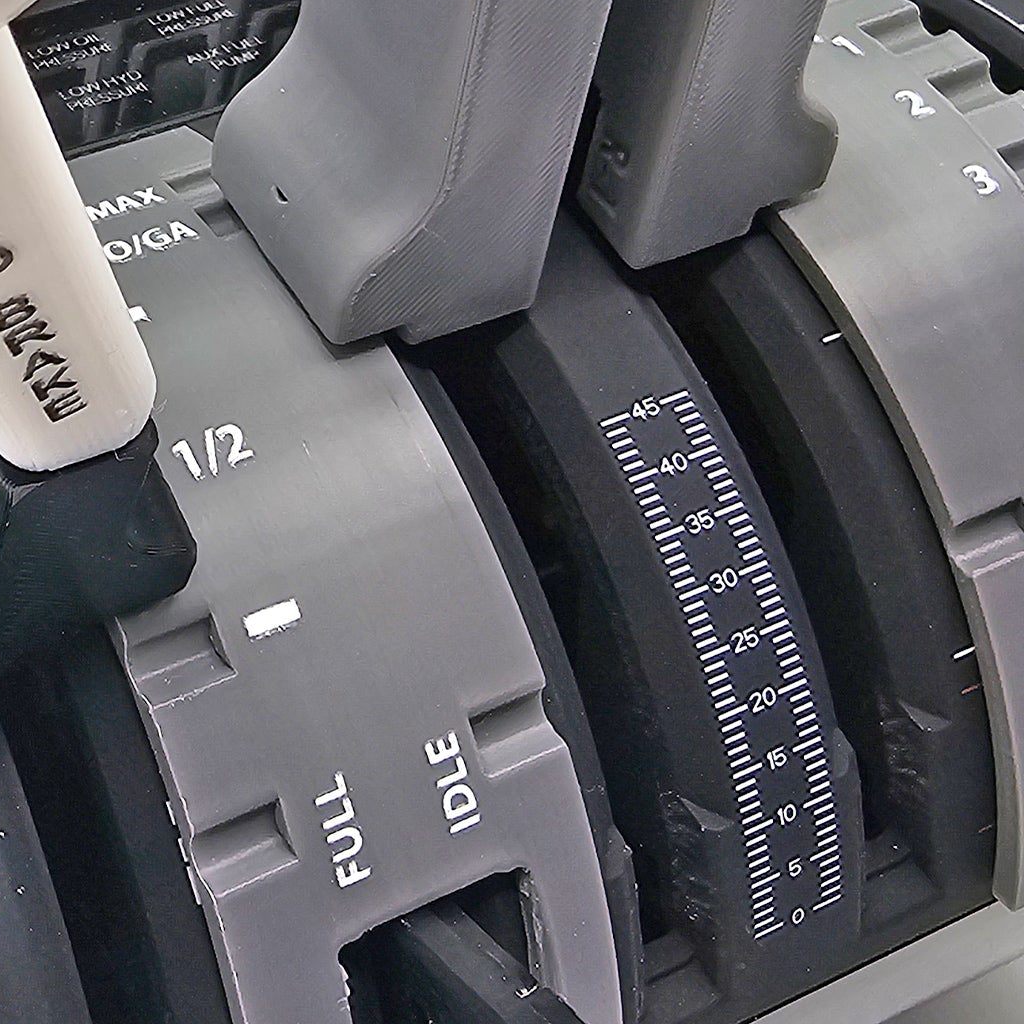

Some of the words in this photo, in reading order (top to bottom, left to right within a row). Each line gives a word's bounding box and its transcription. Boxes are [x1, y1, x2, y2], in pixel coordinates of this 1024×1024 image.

[831, 35, 865, 57] 1
[893, 90, 937, 119] 2
[961, 164, 1001, 196] 3
[85, 186, 166, 222] MAX
[102, 220, 200, 264] O/GA
[631, 396, 661, 421] 45
[170, 422, 256, 482] 1/2
[658, 453, 688, 477] 40
[684, 508, 715, 534] 35
[709, 568, 739, 594] 30
[730, 626, 760, 654] 25
[748, 686, 777, 713] 20
[766, 746, 788, 770] 15
[424, 729, 482, 835] IDLE
[776, 803, 797, 826] 10
[314, 771, 372, 889] FULL
[788, 857, 803, 877] 5
[791, 907, 805, 925] 0
